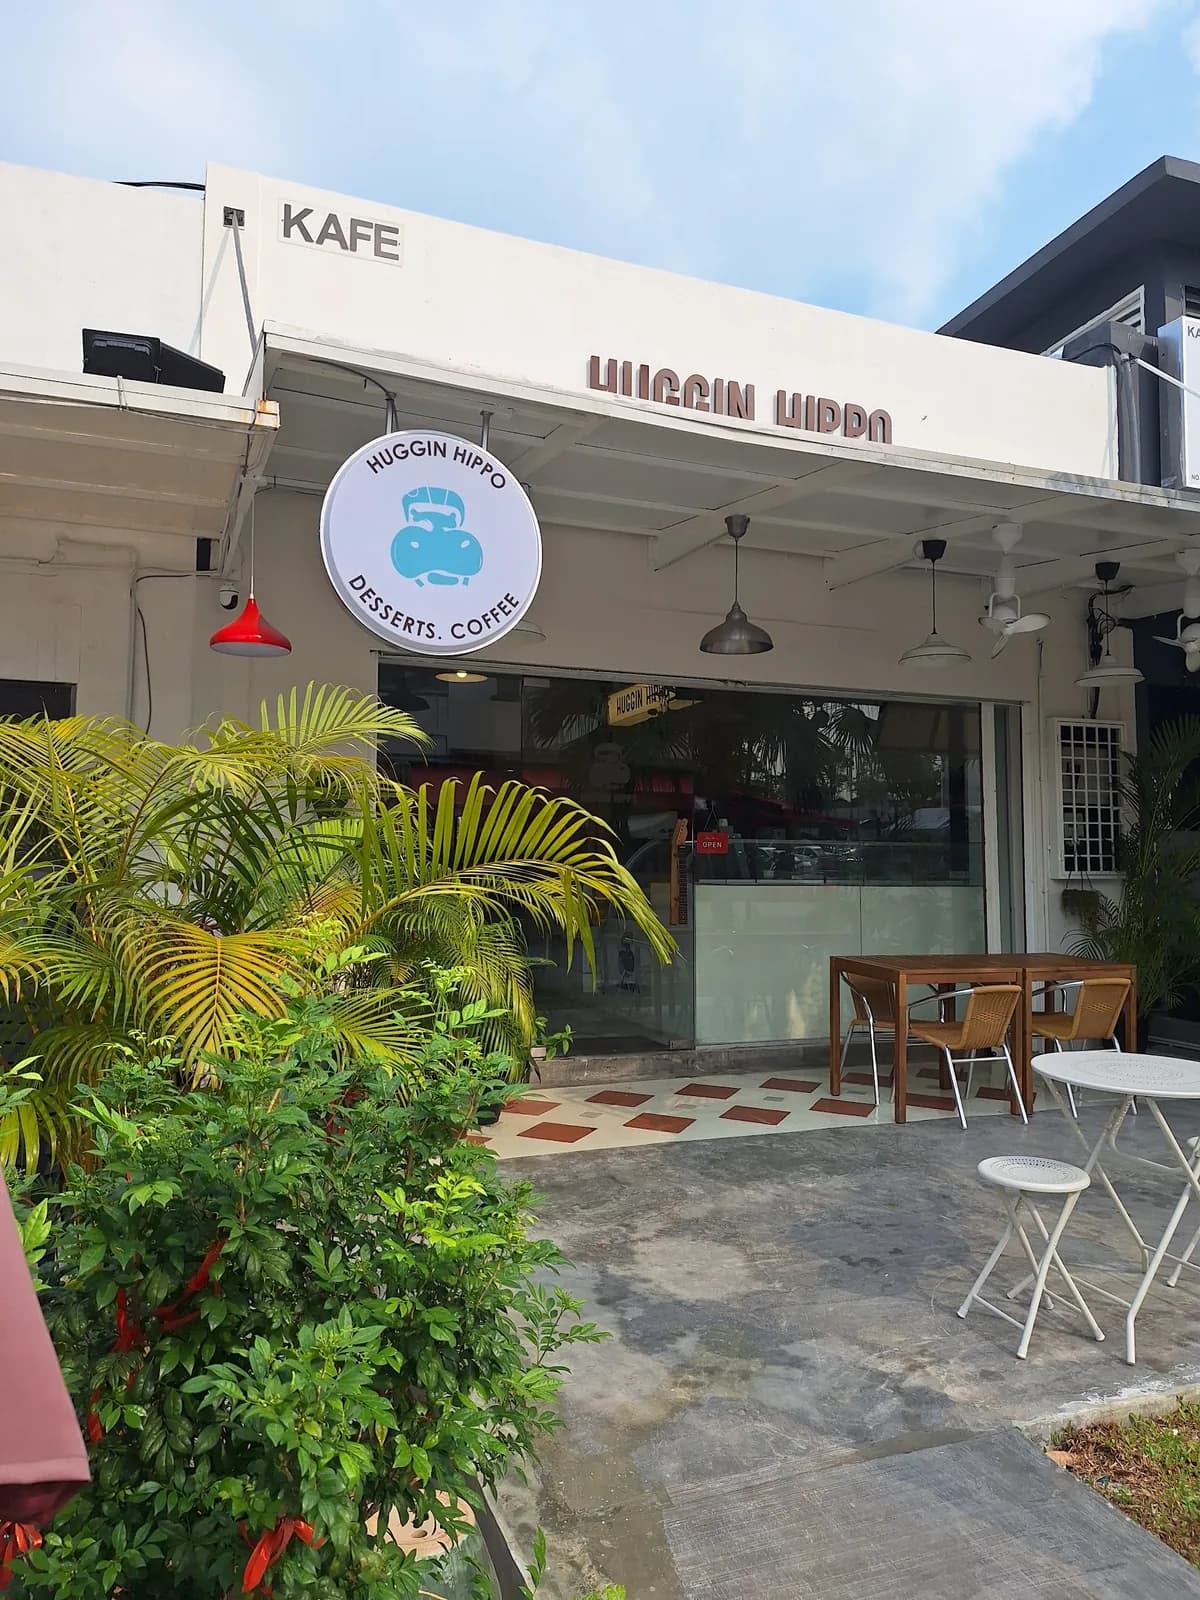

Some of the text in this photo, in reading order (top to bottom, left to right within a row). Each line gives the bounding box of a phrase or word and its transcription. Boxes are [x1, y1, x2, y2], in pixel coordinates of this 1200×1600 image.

[283, 203, 400, 261] KAFE
[590, 355, 755, 421] HUGGIN
[366, 440, 506, 489] HUGGIN HIPPO
[348, 574, 520, 640] DESSERTS. COFFEE
[616, 687, 643, 716] HUGGIN
